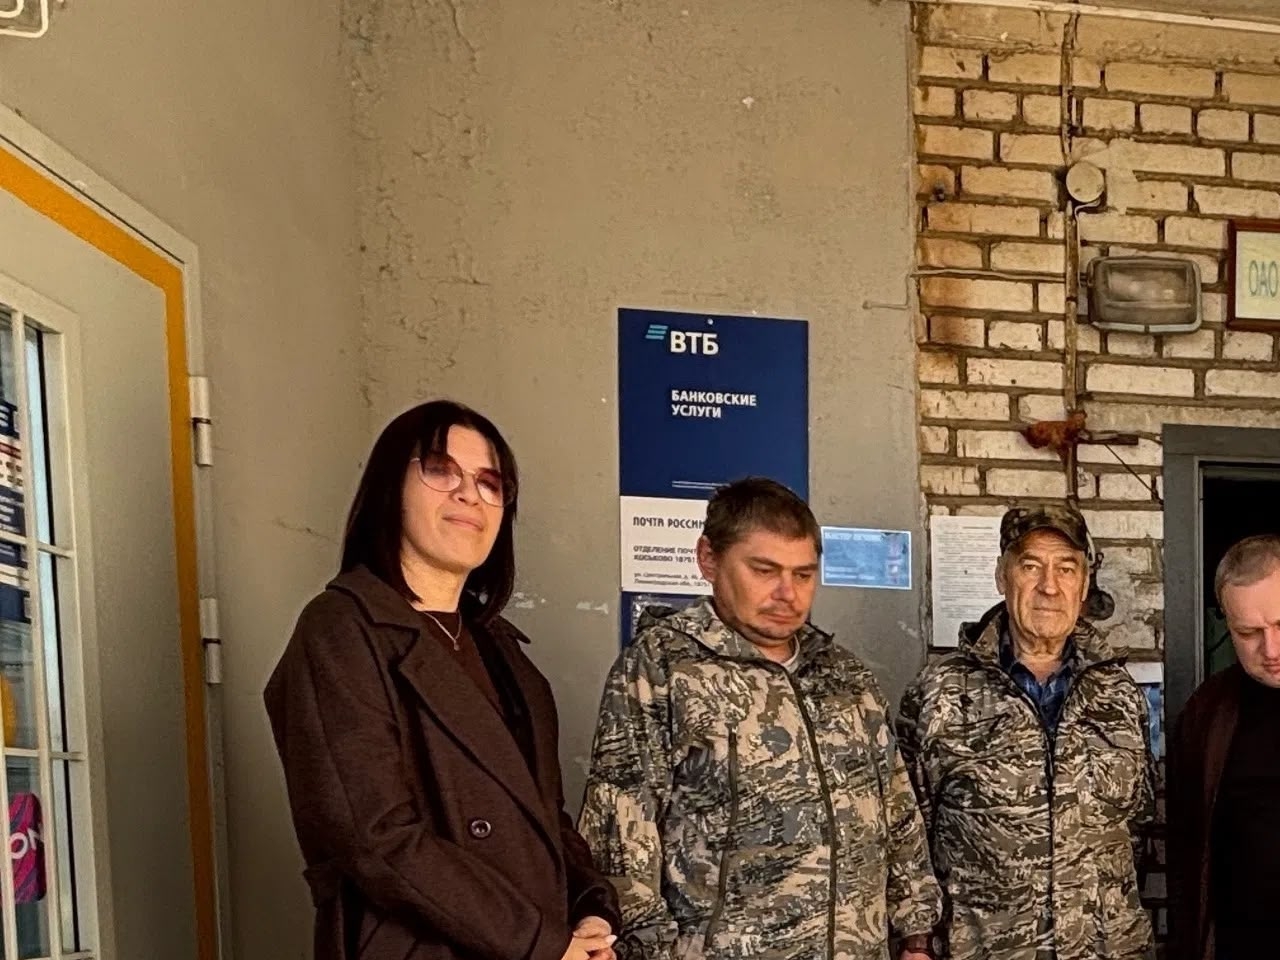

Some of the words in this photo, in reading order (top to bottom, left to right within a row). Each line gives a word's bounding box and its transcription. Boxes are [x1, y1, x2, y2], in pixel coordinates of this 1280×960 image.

[1249, 260, 1278, 298] ОАО
[670, 330, 719, 356] ВТБ
[671, 389, 757, 407] БАНКОВСКИЕ
[671, 403, 722, 419] УСЛУГИ
[633, 516, 665, 528] ПОЧТА
